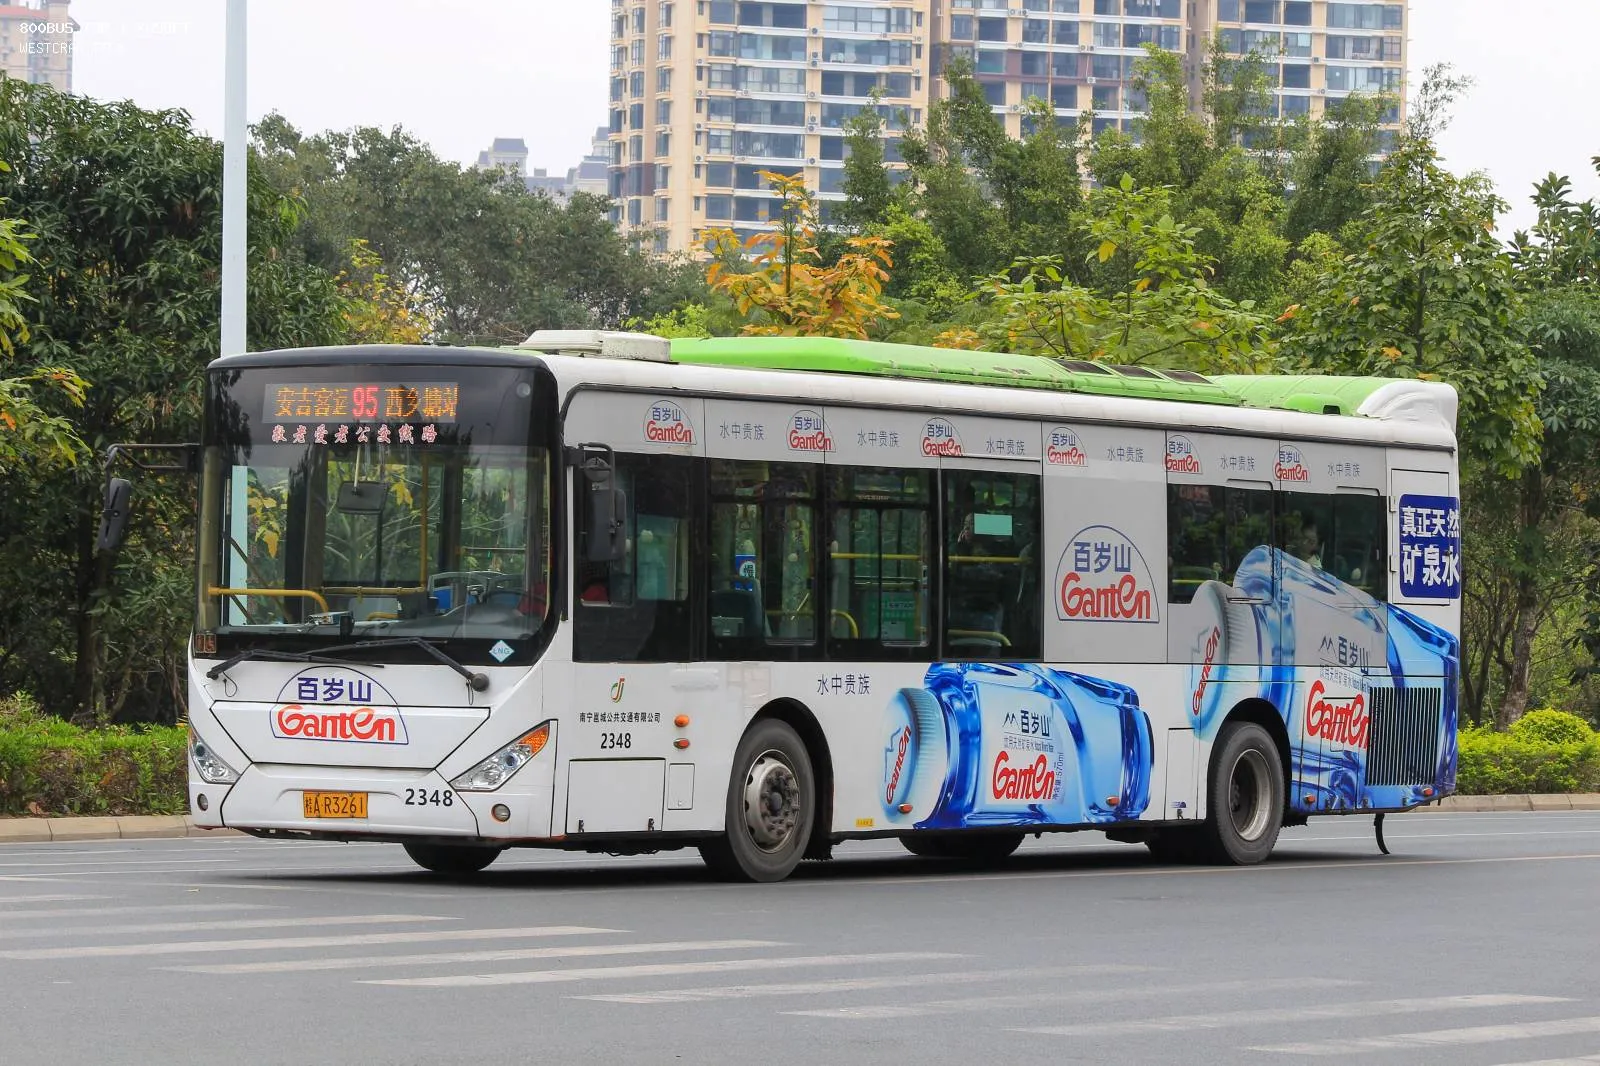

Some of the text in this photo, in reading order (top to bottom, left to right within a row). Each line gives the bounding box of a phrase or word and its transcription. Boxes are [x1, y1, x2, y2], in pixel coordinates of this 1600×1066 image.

[352, 384, 380, 417] 95
[652, 408, 681, 421] 百岁山
[795, 417, 822, 430] 百岁山
[719, 421, 764, 440] 水中贵族
[857, 428, 900, 447] 水中贵族
[927, 425, 953, 438] 百岁山
[986, 438, 1025, 456] 水中贵族
[1052, 434, 1076, 446] 百岁山
[1168, 441, 1191, 454] 百岁山
[1107, 446, 1144, 463] 水中贵族
[1220, 455, 1255, 472] 水中贵族
[1279, 452, 1300, 464] 百岁山
[1327, 462, 1361, 477] 水中贵族
[1402, 505, 1460, 538] 真正天然
[1073, 541, 1131, 573] 百岁山
[1402, 545, 1460, 586] 矿泉水
[493, 647, 510, 655] LNG
[1338, 635, 1369, 675] 百岁山
[298, 677, 372, 703] 百岁山
[816, 673, 871, 696] 水中贵族
[579, 711, 661, 724] 南宁邕城公共交通有限公司
[1020, 709, 1050, 737] 百岁山
[600, 732, 632, 750] 2348
[405, 788, 453, 808] 2348
